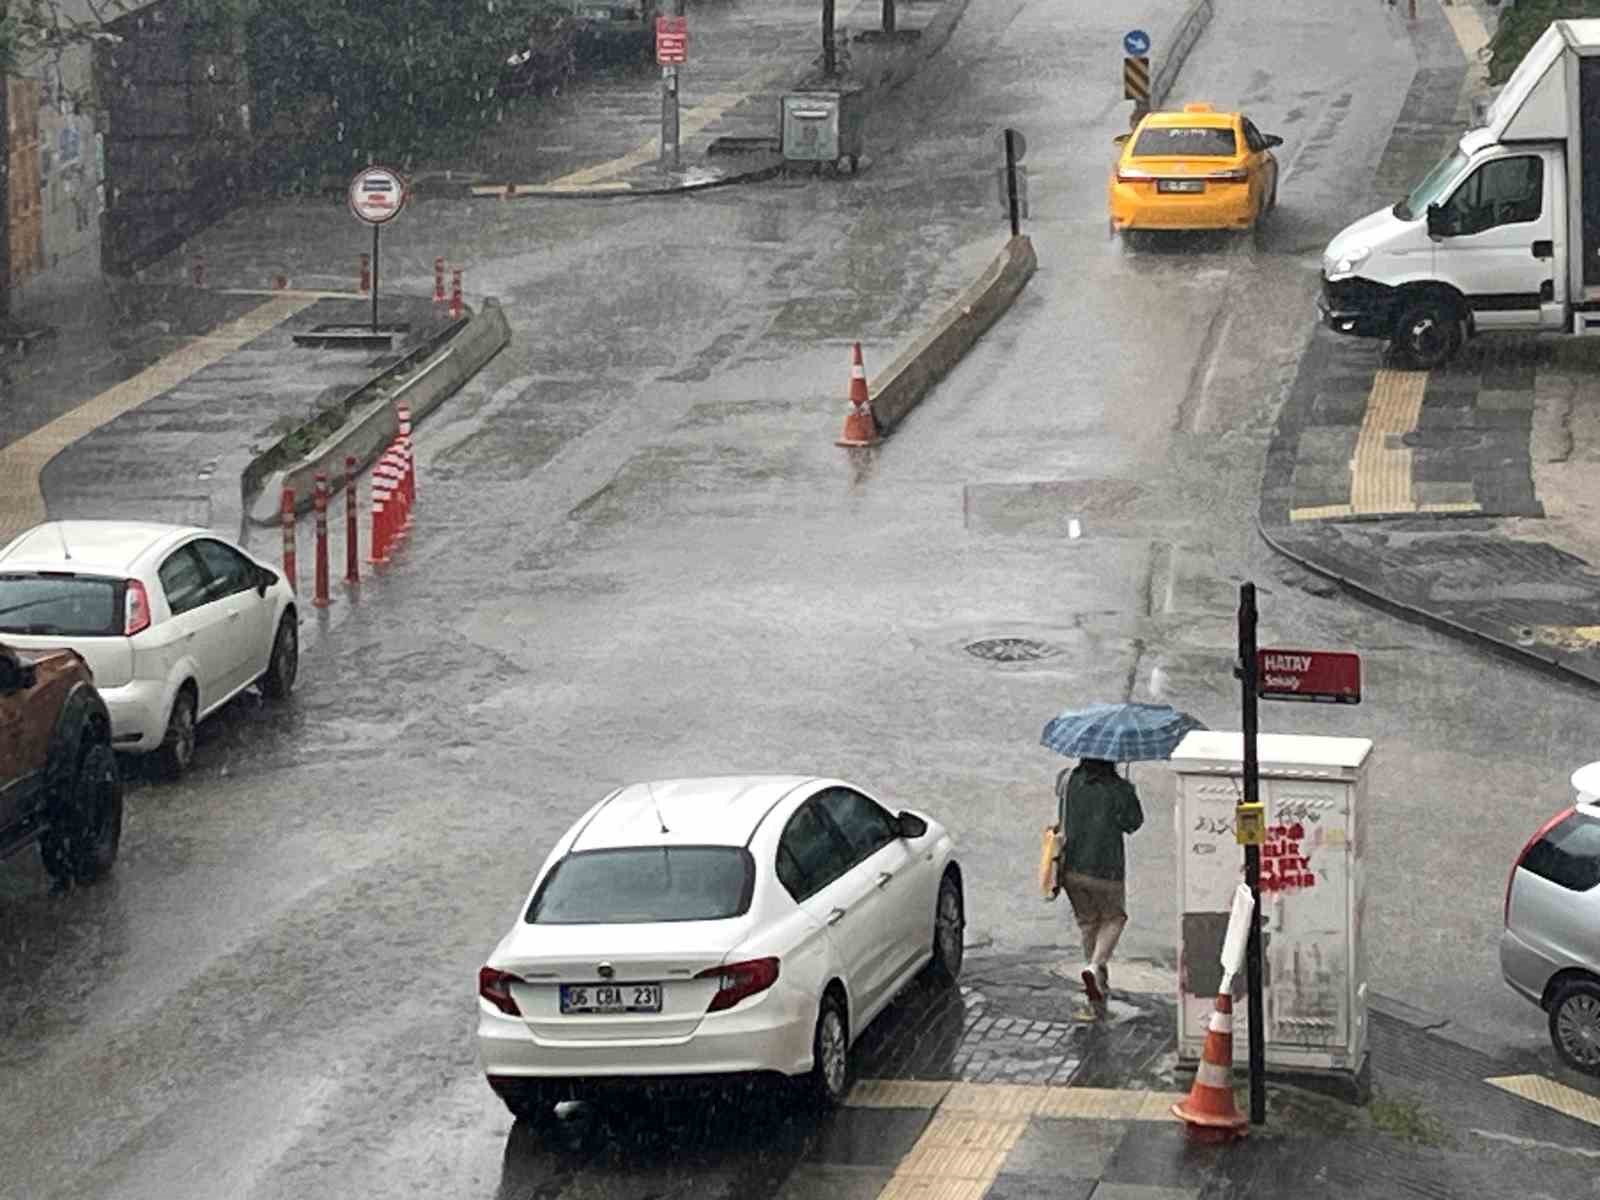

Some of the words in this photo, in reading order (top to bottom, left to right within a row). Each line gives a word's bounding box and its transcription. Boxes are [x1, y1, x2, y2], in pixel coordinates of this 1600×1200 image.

[1264, 654, 1312, 672] HATAY
[571, 988, 588, 1006] 06
[596, 987, 622, 1005] CBA
[633, 986, 657, 1004] 231
